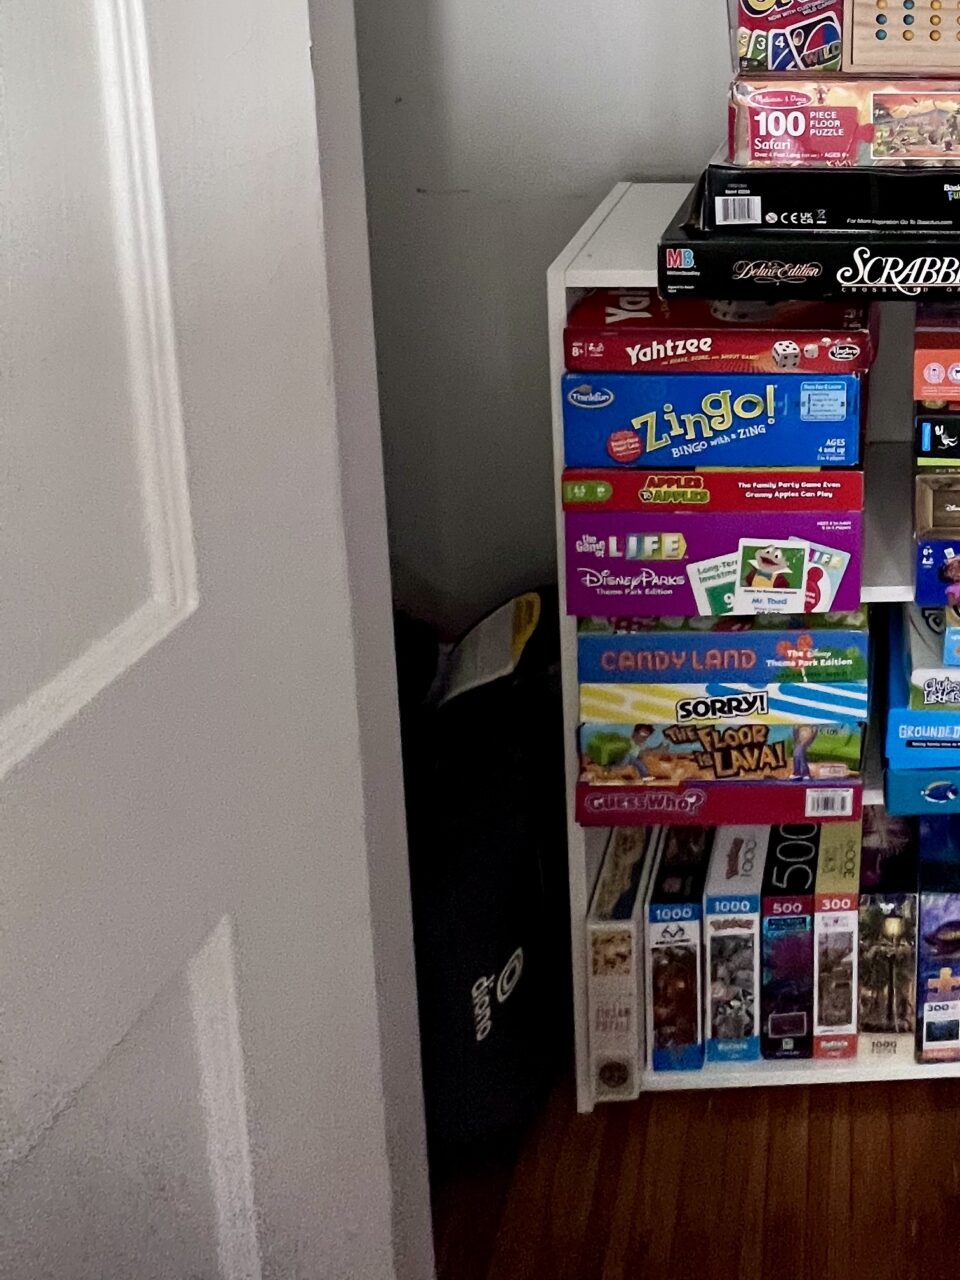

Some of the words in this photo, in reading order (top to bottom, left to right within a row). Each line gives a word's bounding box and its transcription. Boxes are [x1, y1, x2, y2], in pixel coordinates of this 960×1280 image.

[756, 36, 766, 50] 3
[774, 35, 786, 49] 4
[803, 41, 842, 69] WILD
[809, 111, 837, 119] PIECE
[754, 110, 806, 137] 100
[809, 120, 841, 128] FLOOR
[809, 128, 845, 137] PUZZLE
[754, 137, 791, 150] Safari
[666, 248, 695, 269] MB
[732, 260, 780, 281] Deluxe
[779, 260, 823, 279] Edition
[625, 337, 713, 366] Yahtzee
[631, 384, 776, 453] Zingo!
[671, 440, 708, 458] BINGO
[710, 433, 731, 448] with
[737, 424, 767, 441] ZING
[825, 438, 846, 446] AGES
[752, 481, 777, 489] Family
[778, 481, 800, 489] Party
[653, 490, 709, 502] APPLES
[745, 491, 773, 499] Granny
[774, 491, 799, 499] Apples
[582, 533, 597, 544] the
[575, 540, 606, 553] Game
[608, 535, 680, 558] LIFE
[596, 588, 623, 596] Theme
[624, 588, 642, 596] Park
[644, 587, 673, 596] Edition
[787, 649, 804, 657] The
[766, 659, 796, 667] Theme
[798, 659, 818, 667] Park
[820, 657, 853, 666] Edition
[678, 693, 768, 720] SORRY!
[664, 724, 698, 743] THE
[699, 723, 769, 751] FLOOR
[899, 725, 960, 739] GROUNDED
[712, 741, 787, 778] LAVA!
[588, 792, 649, 812] GUESS
[649, 790, 704, 812] Who?
[772, 824, 818, 889] 500
[714, 900, 751, 913] 1000
[773, 902, 802, 914] 500
[821, 898, 851, 910] 300
[655, 907, 693, 920] 1000
